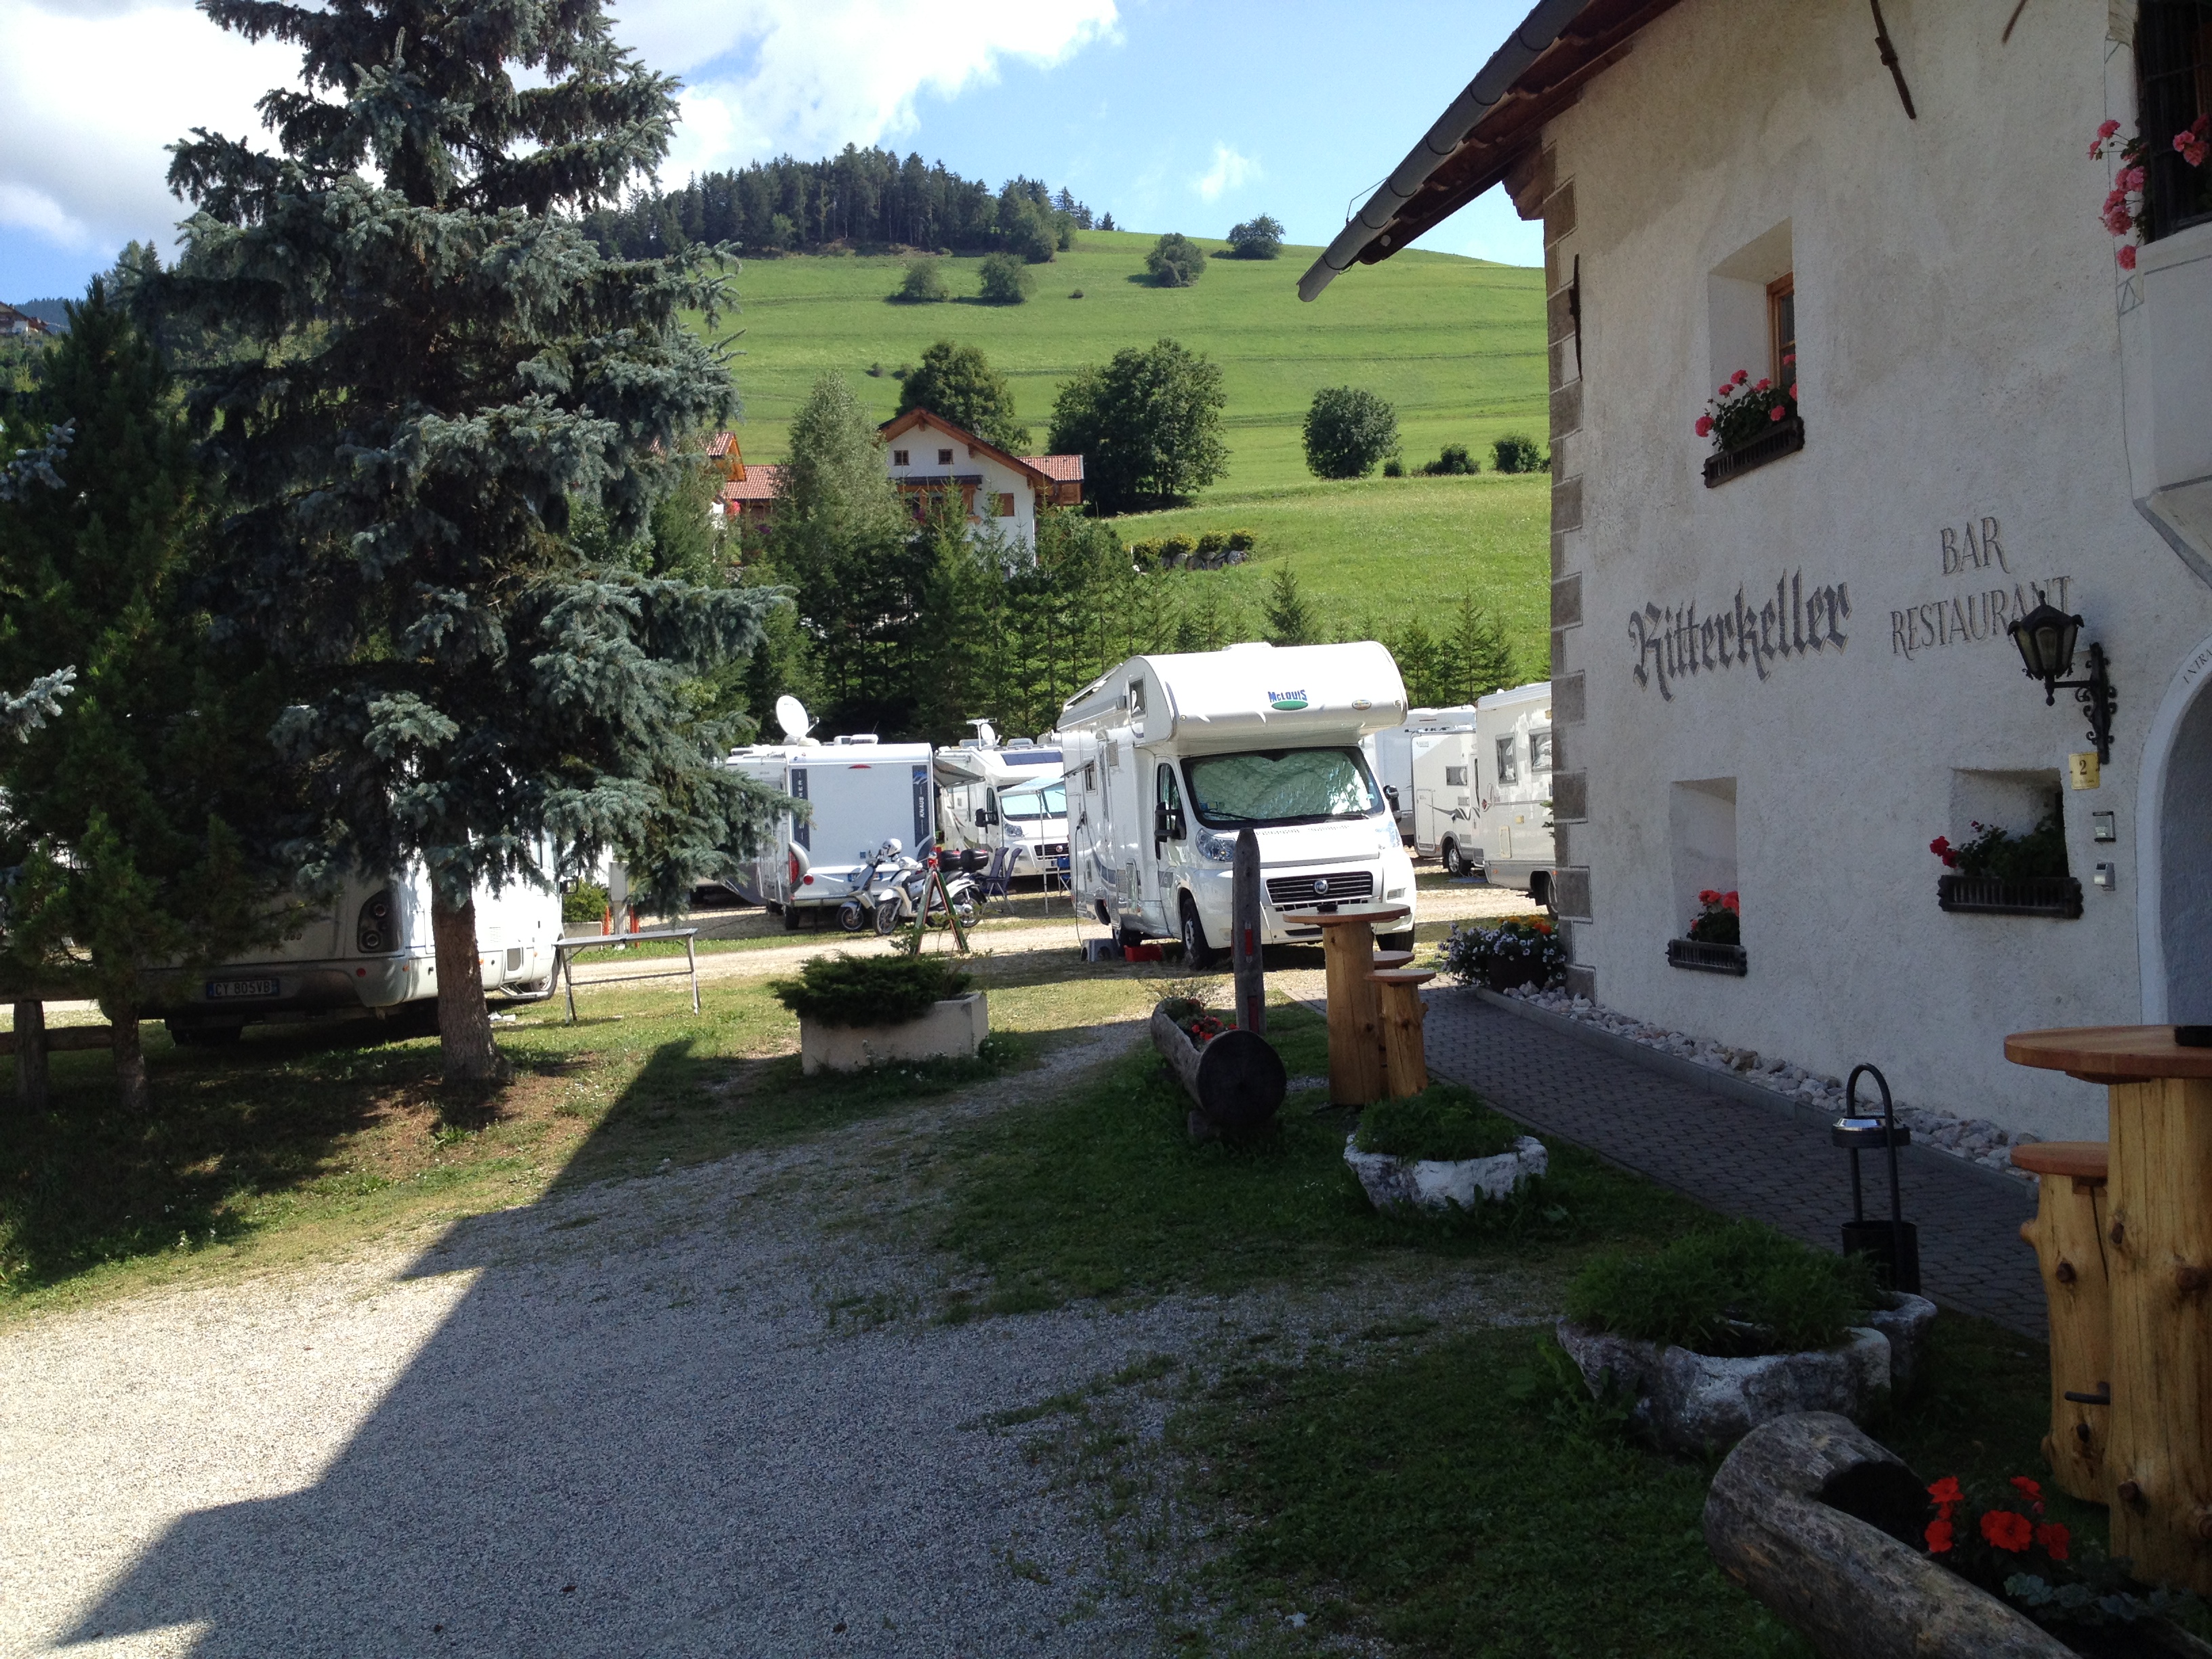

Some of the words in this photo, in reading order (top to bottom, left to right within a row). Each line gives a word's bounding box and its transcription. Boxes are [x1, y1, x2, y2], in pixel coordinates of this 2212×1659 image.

[1940, 516, 2012, 576] BAR
[1628, 565, 1853, 703] Ritterkeller
[2079, 760, 2087, 775] 2
[215, 983, 229, 996] CY
